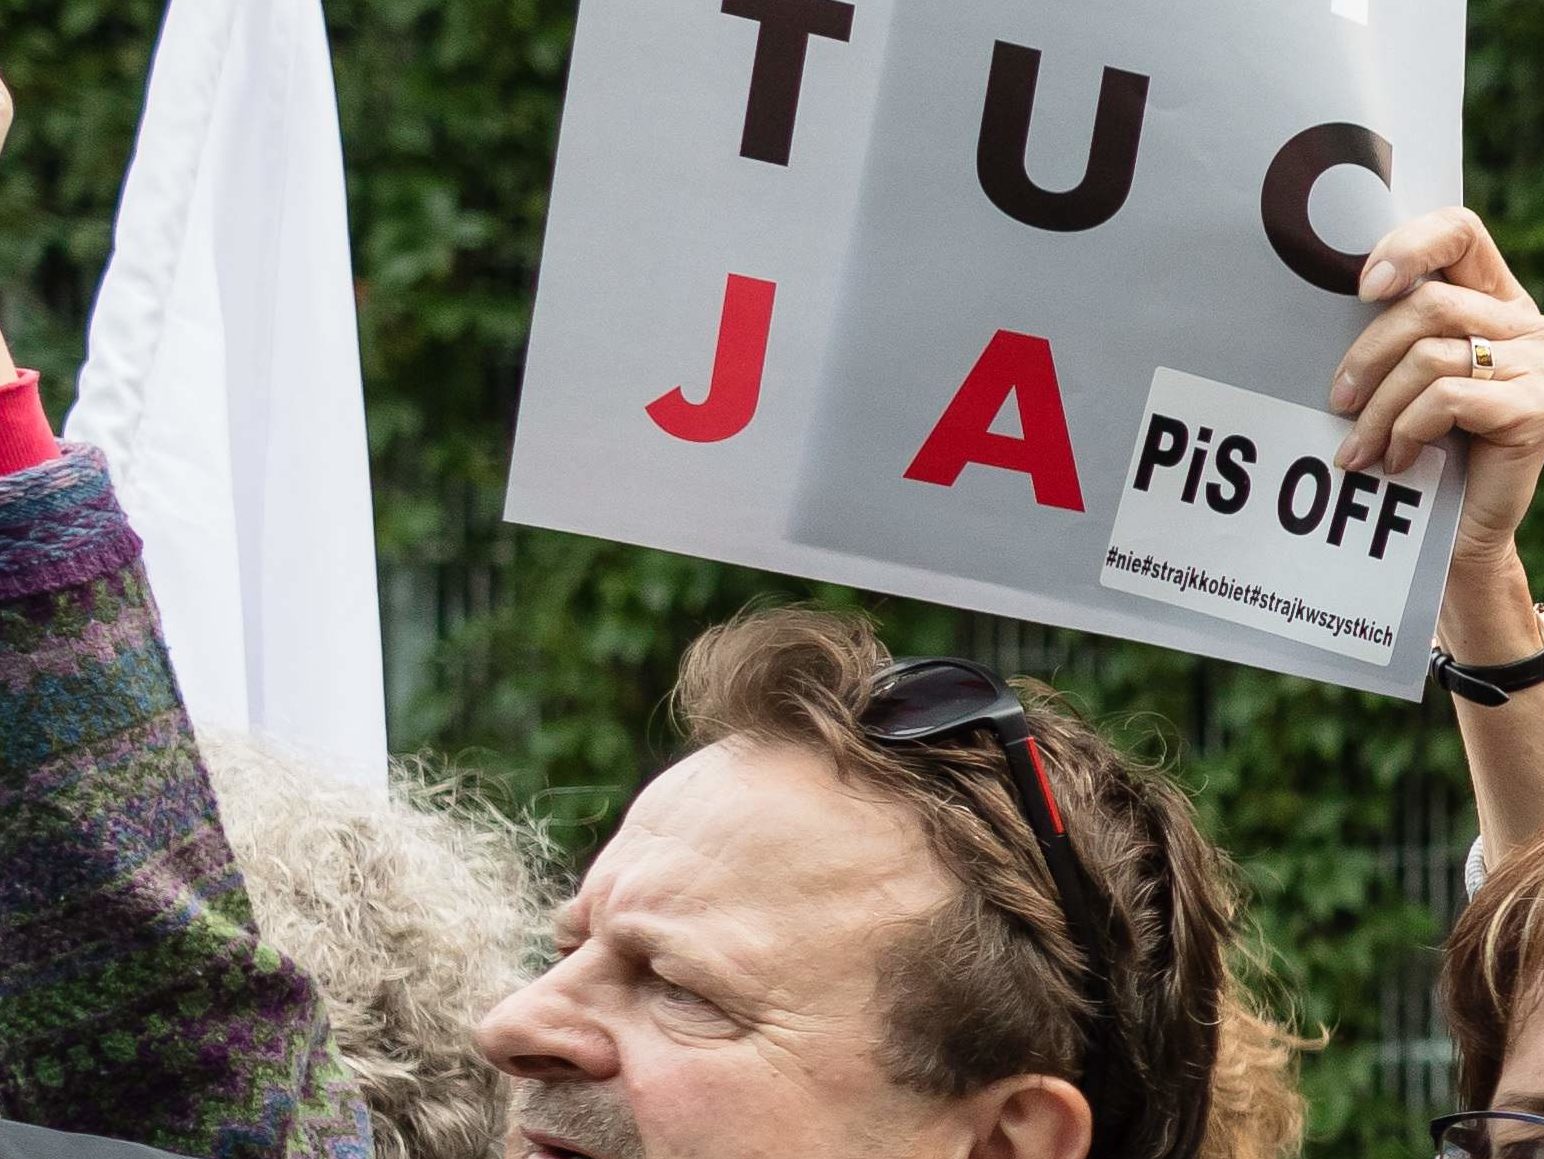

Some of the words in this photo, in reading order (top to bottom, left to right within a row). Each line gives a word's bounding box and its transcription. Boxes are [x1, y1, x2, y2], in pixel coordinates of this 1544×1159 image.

[721, 0, 1393, 297] TUC
[645, 273, 1085, 513] JA
[1133, 413, 1257, 515] PiS
[1277, 456, 1423, 560] OFF
[1106, 546, 1394, 648] #nie#strajkkobiet#strajkwszystkich
